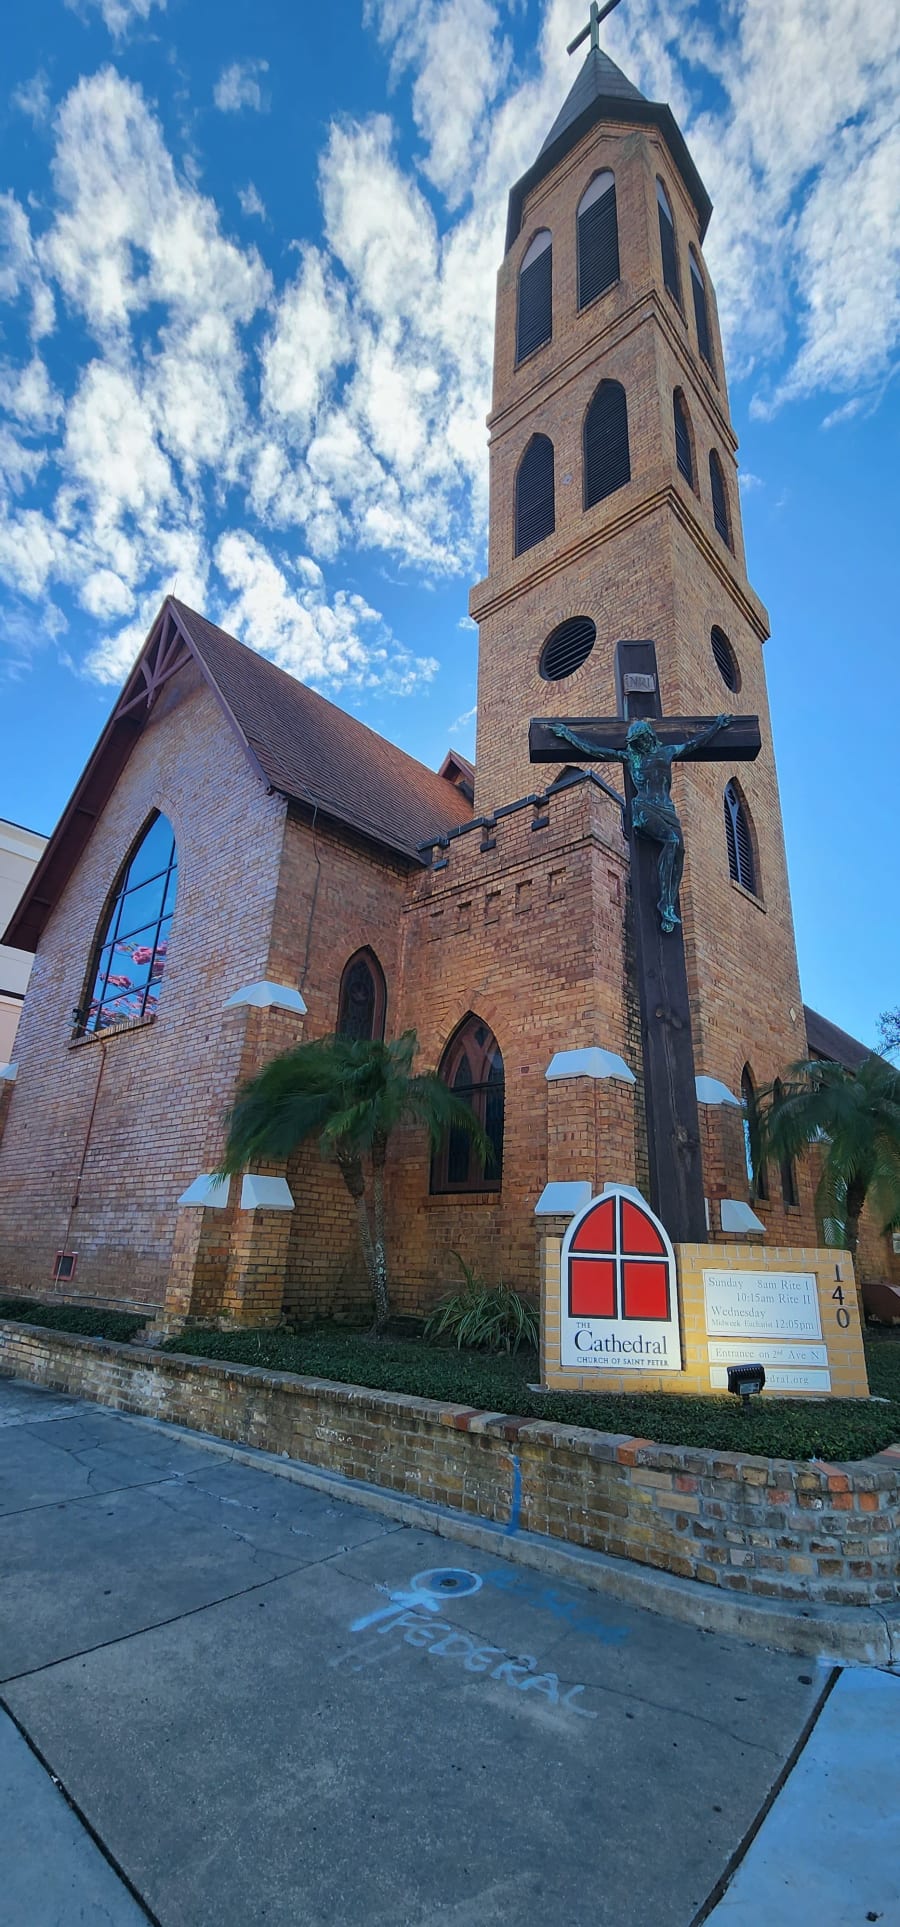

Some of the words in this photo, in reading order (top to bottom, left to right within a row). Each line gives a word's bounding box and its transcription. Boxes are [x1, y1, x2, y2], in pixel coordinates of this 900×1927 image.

[708, 1277, 744, 1289] Sunday
[757, 1280, 777, 1289] 8am
[781, 1280, 801, 1290] Rite
[737, 1292, 775, 1303] 10:15am
[779, 1294, 799, 1304] Rite
[803, 1295, 811, 1305] II
[832, 1264, 850, 1328] 140
[711, 1305, 766, 1318] Wednesday
[711, 1319, 742, 1328] Midweek
[775, 1319, 814, 1331] 12:05pm
[574, 1329, 668, 1355] Cathedral
[716, 1347, 754, 1358] Entrance
[758, 1351, 770, 1359] on
[788, 1350, 806, 1360] Ave
[811, 1351, 820, 1360] N
[577, 1356, 609, 1365] CHURCH
[611, 1357, 622, 1365] OF
[623, 1358, 645, 1366] SAINT
[647, 1359, 670, 1367] PETER
[764, 1375, 809, 1385] edral.org
[376, 1610, 598, 1719] FEDERAL
